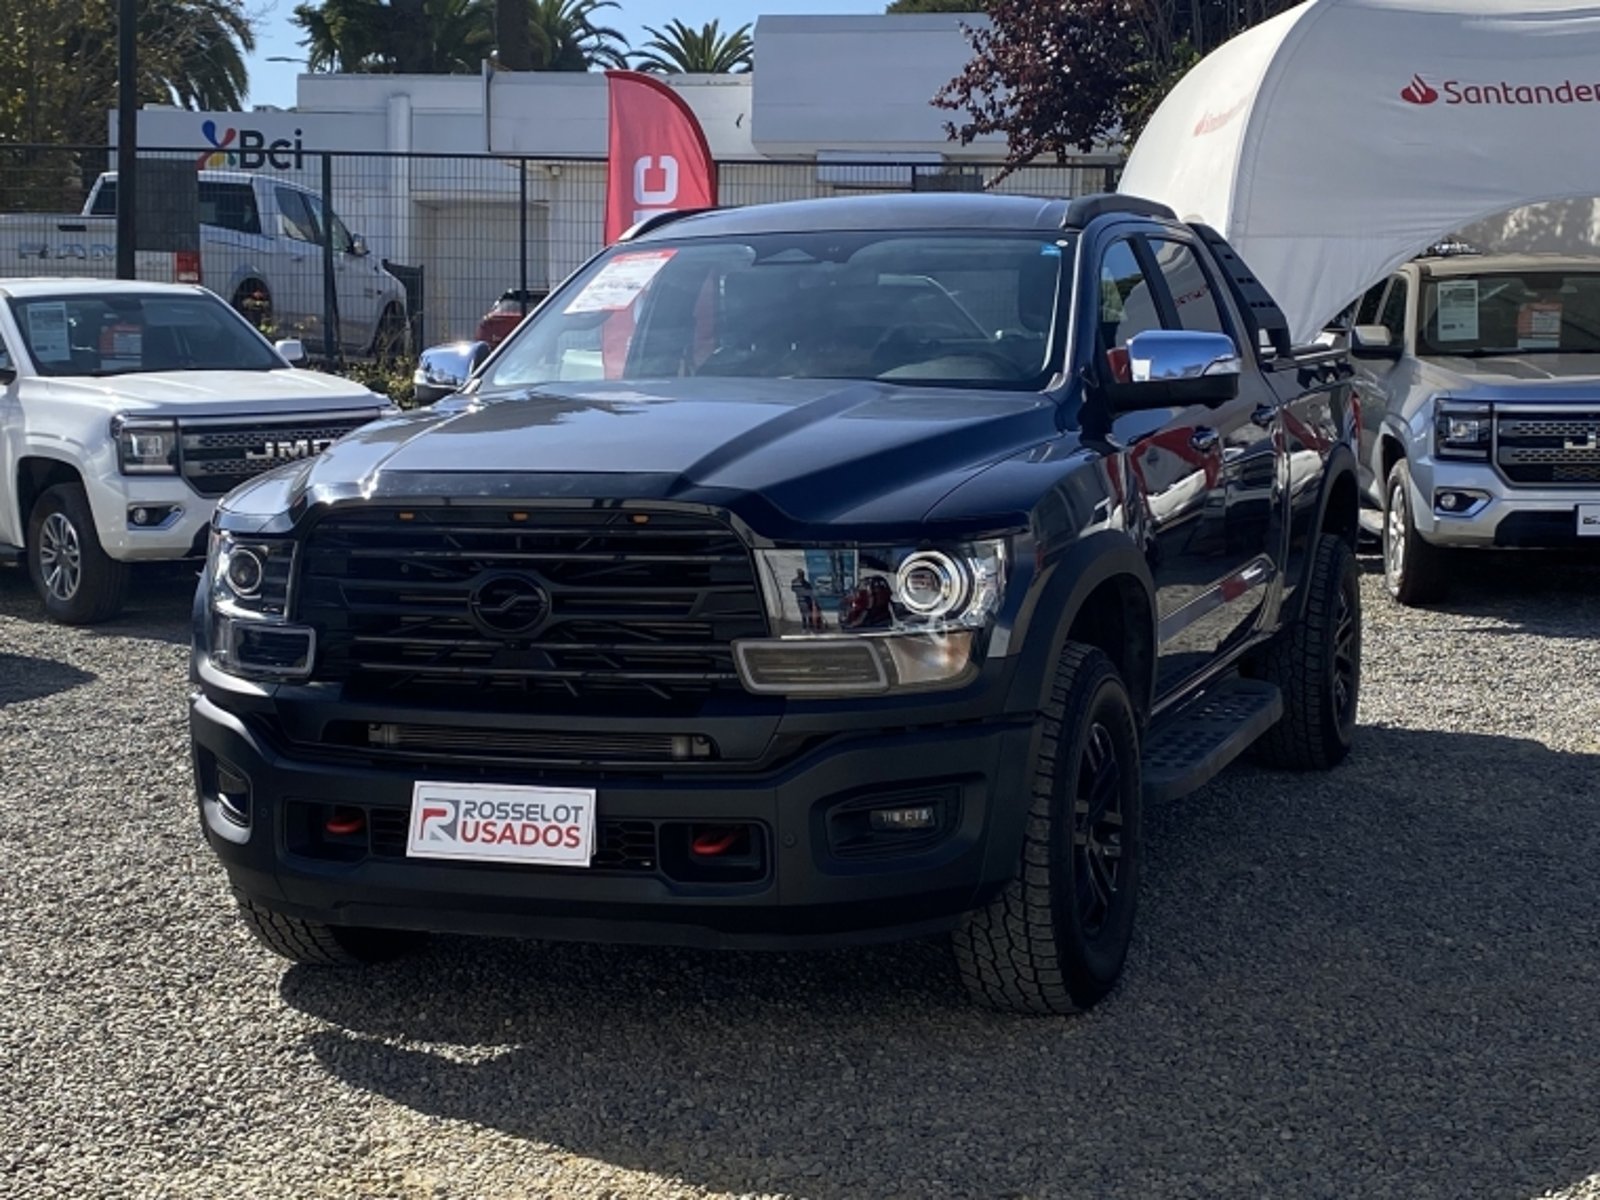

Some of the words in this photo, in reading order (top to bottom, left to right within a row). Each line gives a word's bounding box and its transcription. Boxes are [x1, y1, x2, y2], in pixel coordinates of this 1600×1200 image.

[239, 129, 303, 170] Bci
[462, 801, 584, 823] ROSSELOT
[460, 821, 581, 849] USADOS
